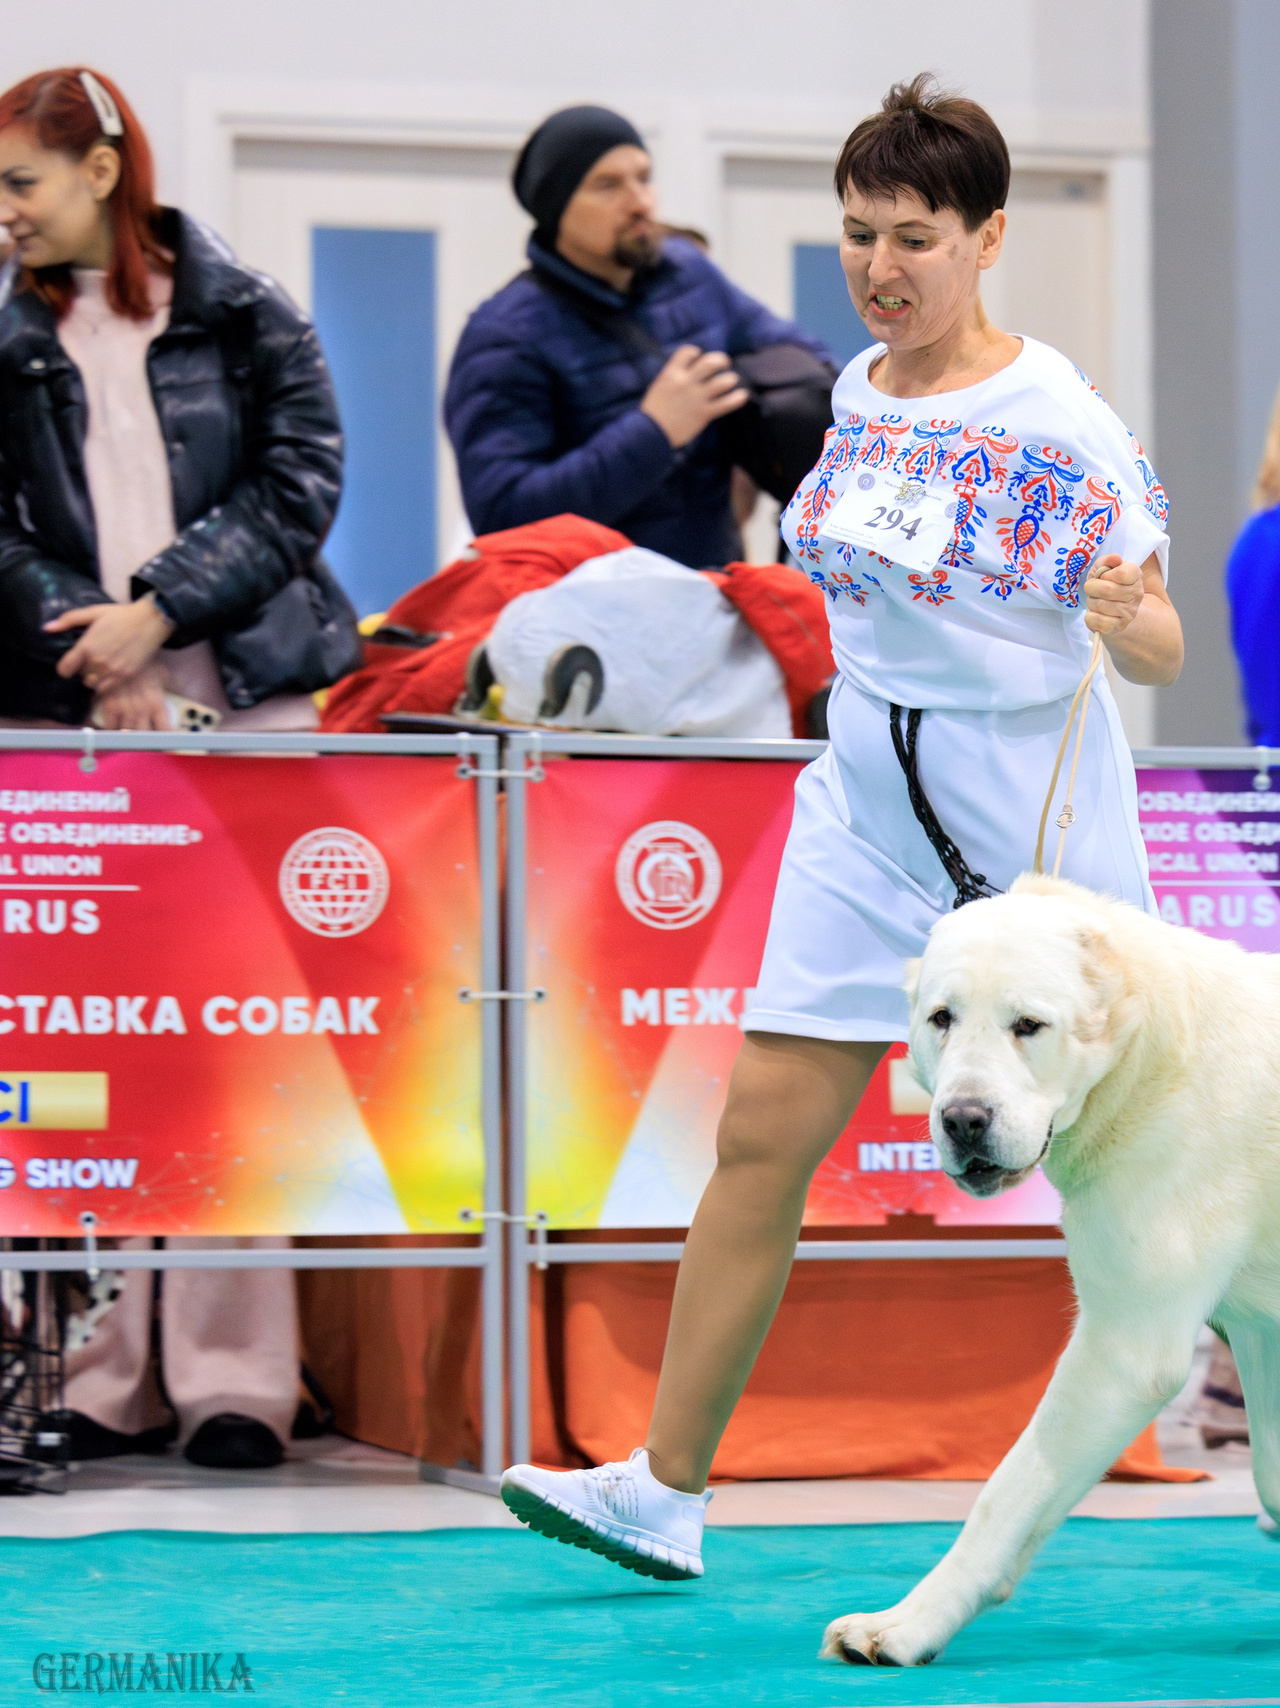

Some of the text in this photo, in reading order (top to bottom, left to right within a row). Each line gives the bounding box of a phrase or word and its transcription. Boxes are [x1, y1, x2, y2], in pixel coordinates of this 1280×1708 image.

[863, 506, 923, 541] 294
[22, 854, 103, 877] UNION
[1204, 852, 1279, 874] UNION
[311, 873, 358, 890] FCI
[3, 898, 100, 935] RUS
[202, 995, 382, 1037] СОБАК
[25, 1157, 140, 1190] SHOW
